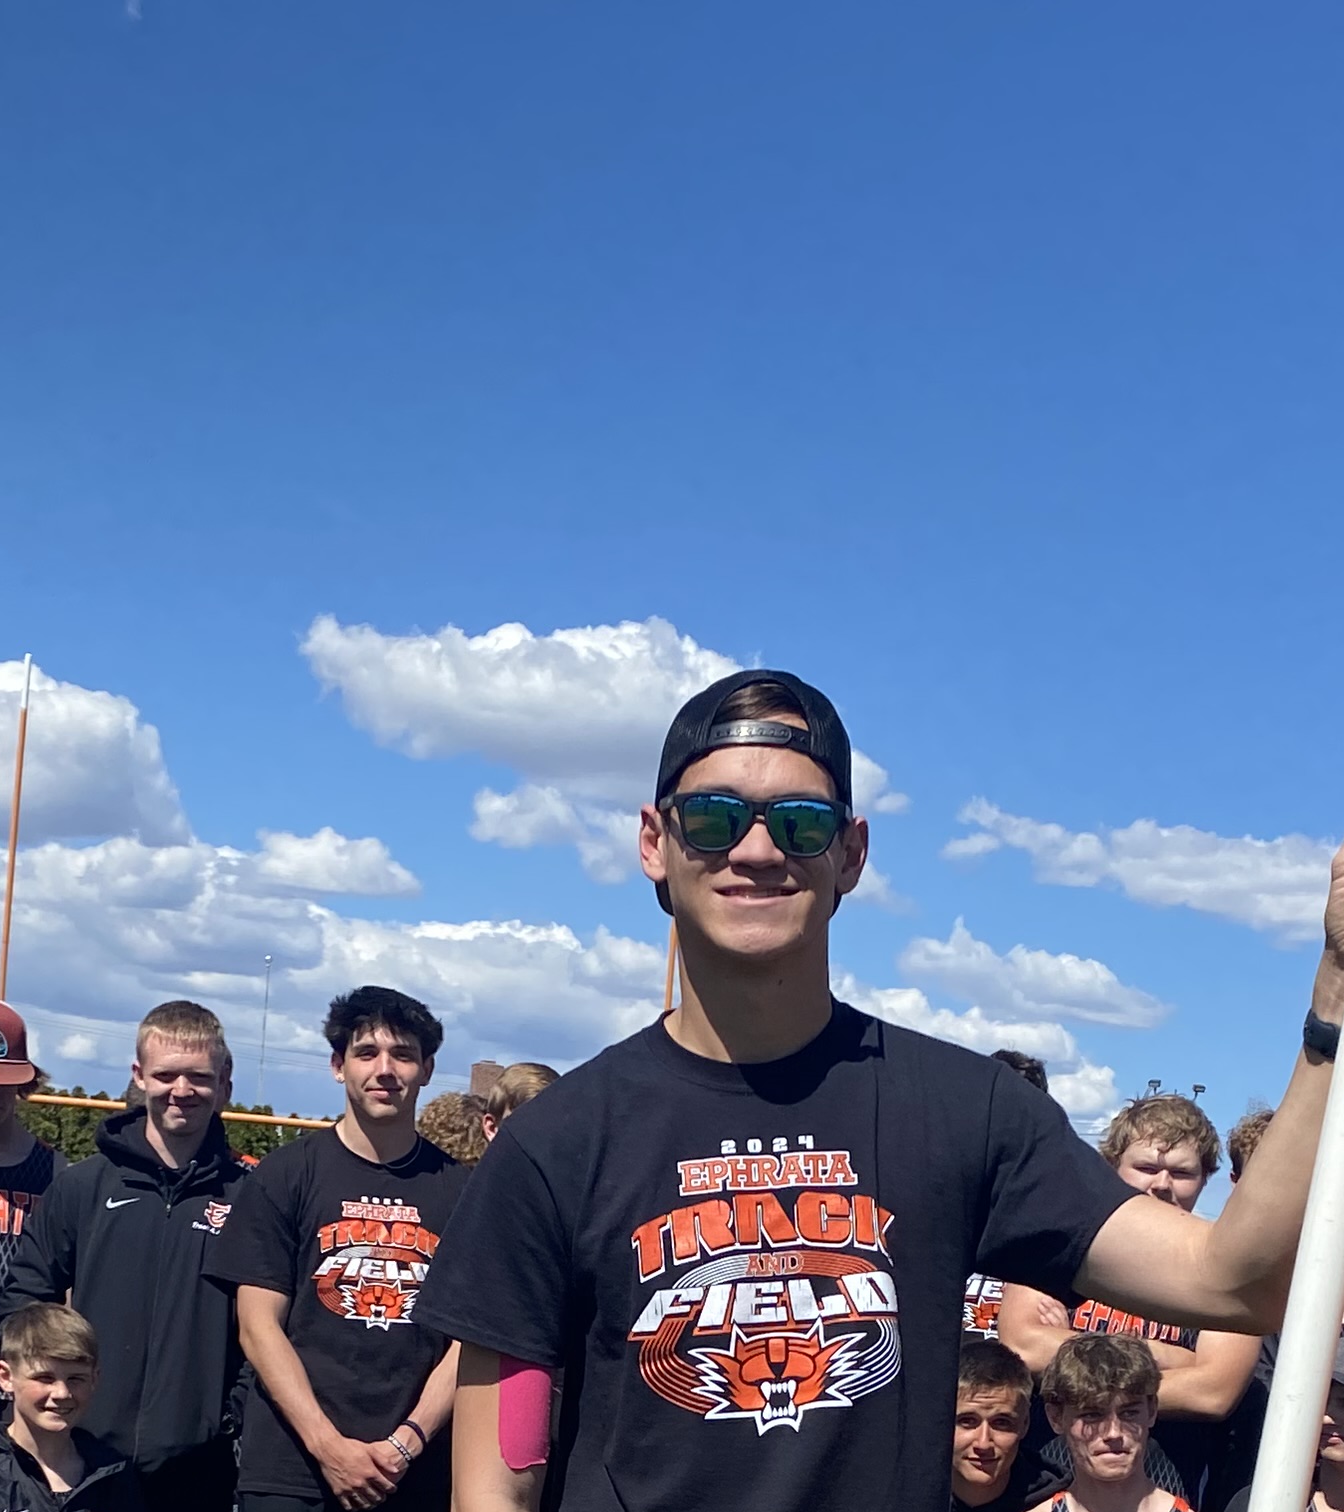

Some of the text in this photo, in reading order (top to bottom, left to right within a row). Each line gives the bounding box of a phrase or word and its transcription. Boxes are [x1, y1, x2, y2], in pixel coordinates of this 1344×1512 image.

[720, 1134, 814, 1154] 2024
[677, 1151, 858, 1196] EPHRATA
[341, 1201, 421, 1223] EPHRATA
[317, 1219, 441, 1259] TRACK
[632, 1191, 895, 1283] TRACK
[745, 1252, 803, 1275] AND
[628, 1271, 897, 1337] FIELD
